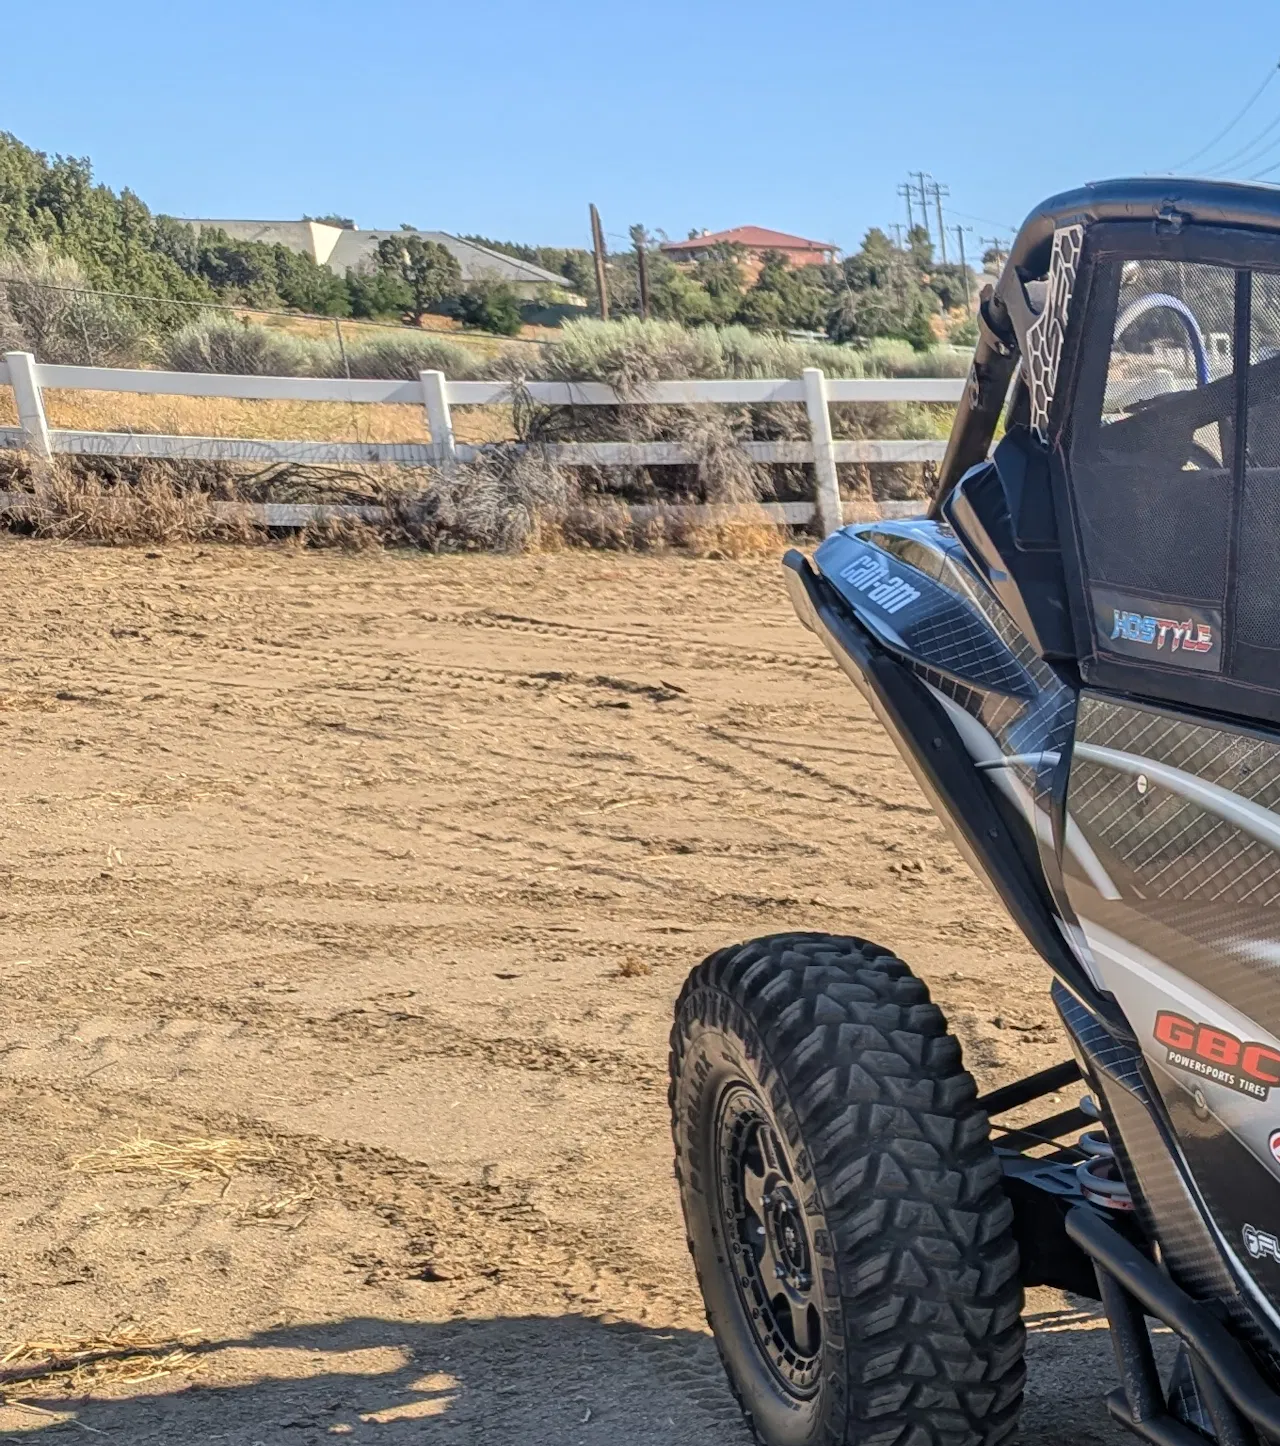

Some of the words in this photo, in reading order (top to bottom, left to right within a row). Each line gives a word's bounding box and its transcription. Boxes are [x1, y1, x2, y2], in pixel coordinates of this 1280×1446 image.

[1110, 608, 1213, 653] HOSTYLE
[1168, 1051, 1235, 1085] POWERSPORTS
[1239, 1078, 1266, 1097] TIRES
